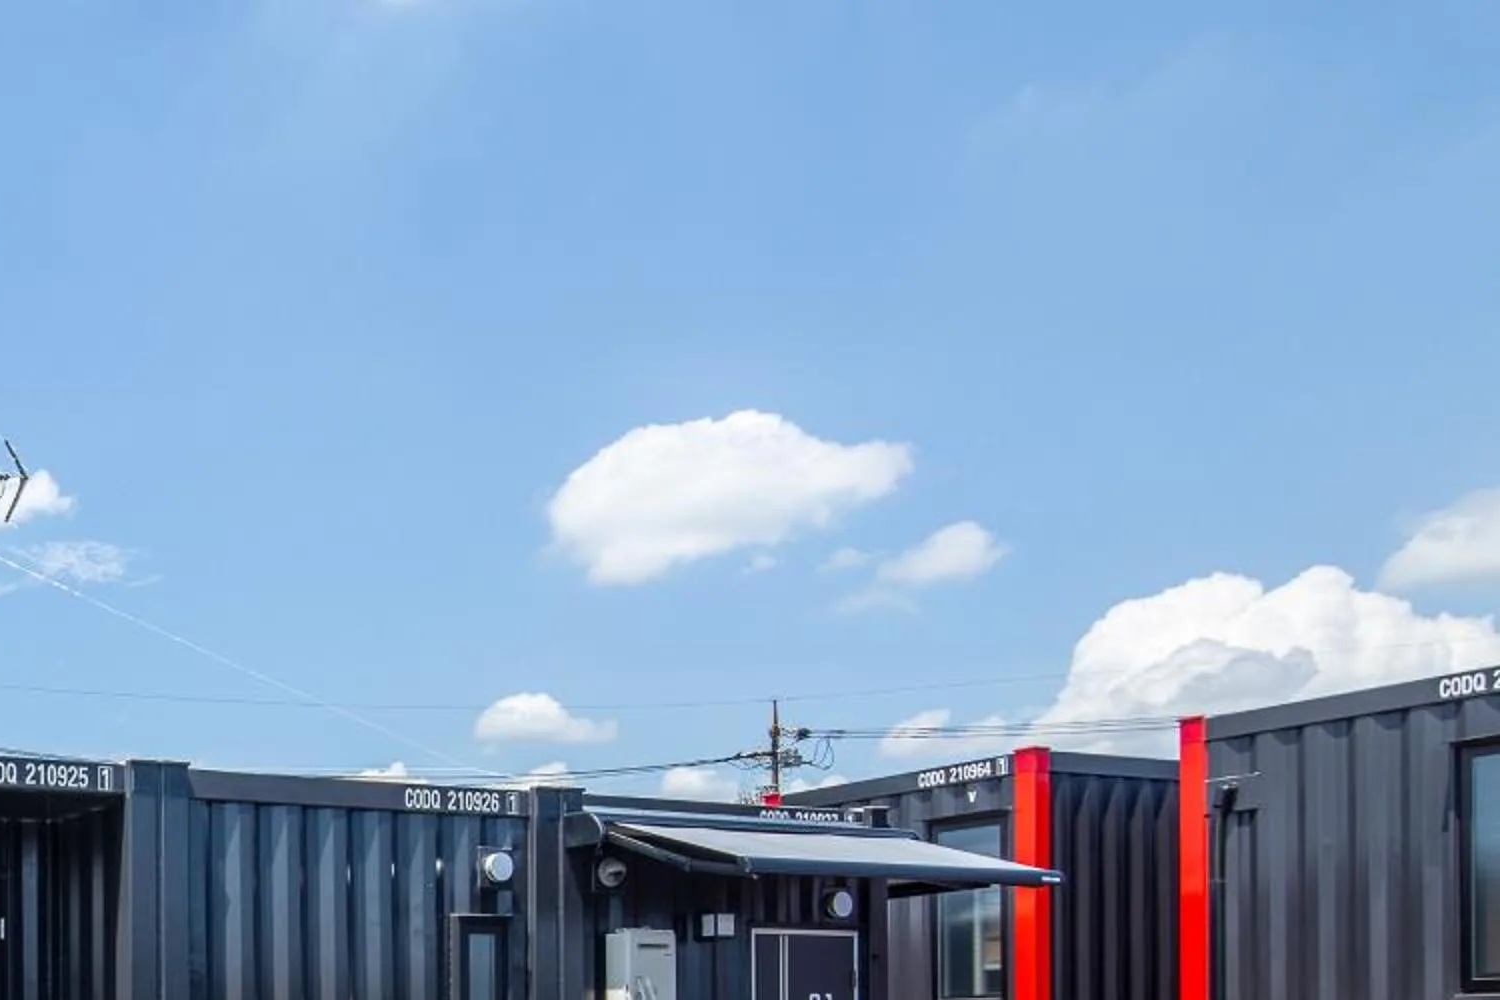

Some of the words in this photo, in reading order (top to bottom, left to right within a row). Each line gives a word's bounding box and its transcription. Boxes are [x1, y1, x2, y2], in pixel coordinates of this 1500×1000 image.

[1439, 671, 1487, 698] CODQ
[25, 763, 89, 788] 210925
[100, 767, 111, 790] 1
[918, 769, 946, 788] CODQ
[949, 761, 991, 783] 210964
[405, 787, 441, 809] CODQ
[447, 790, 500, 813] 210926
